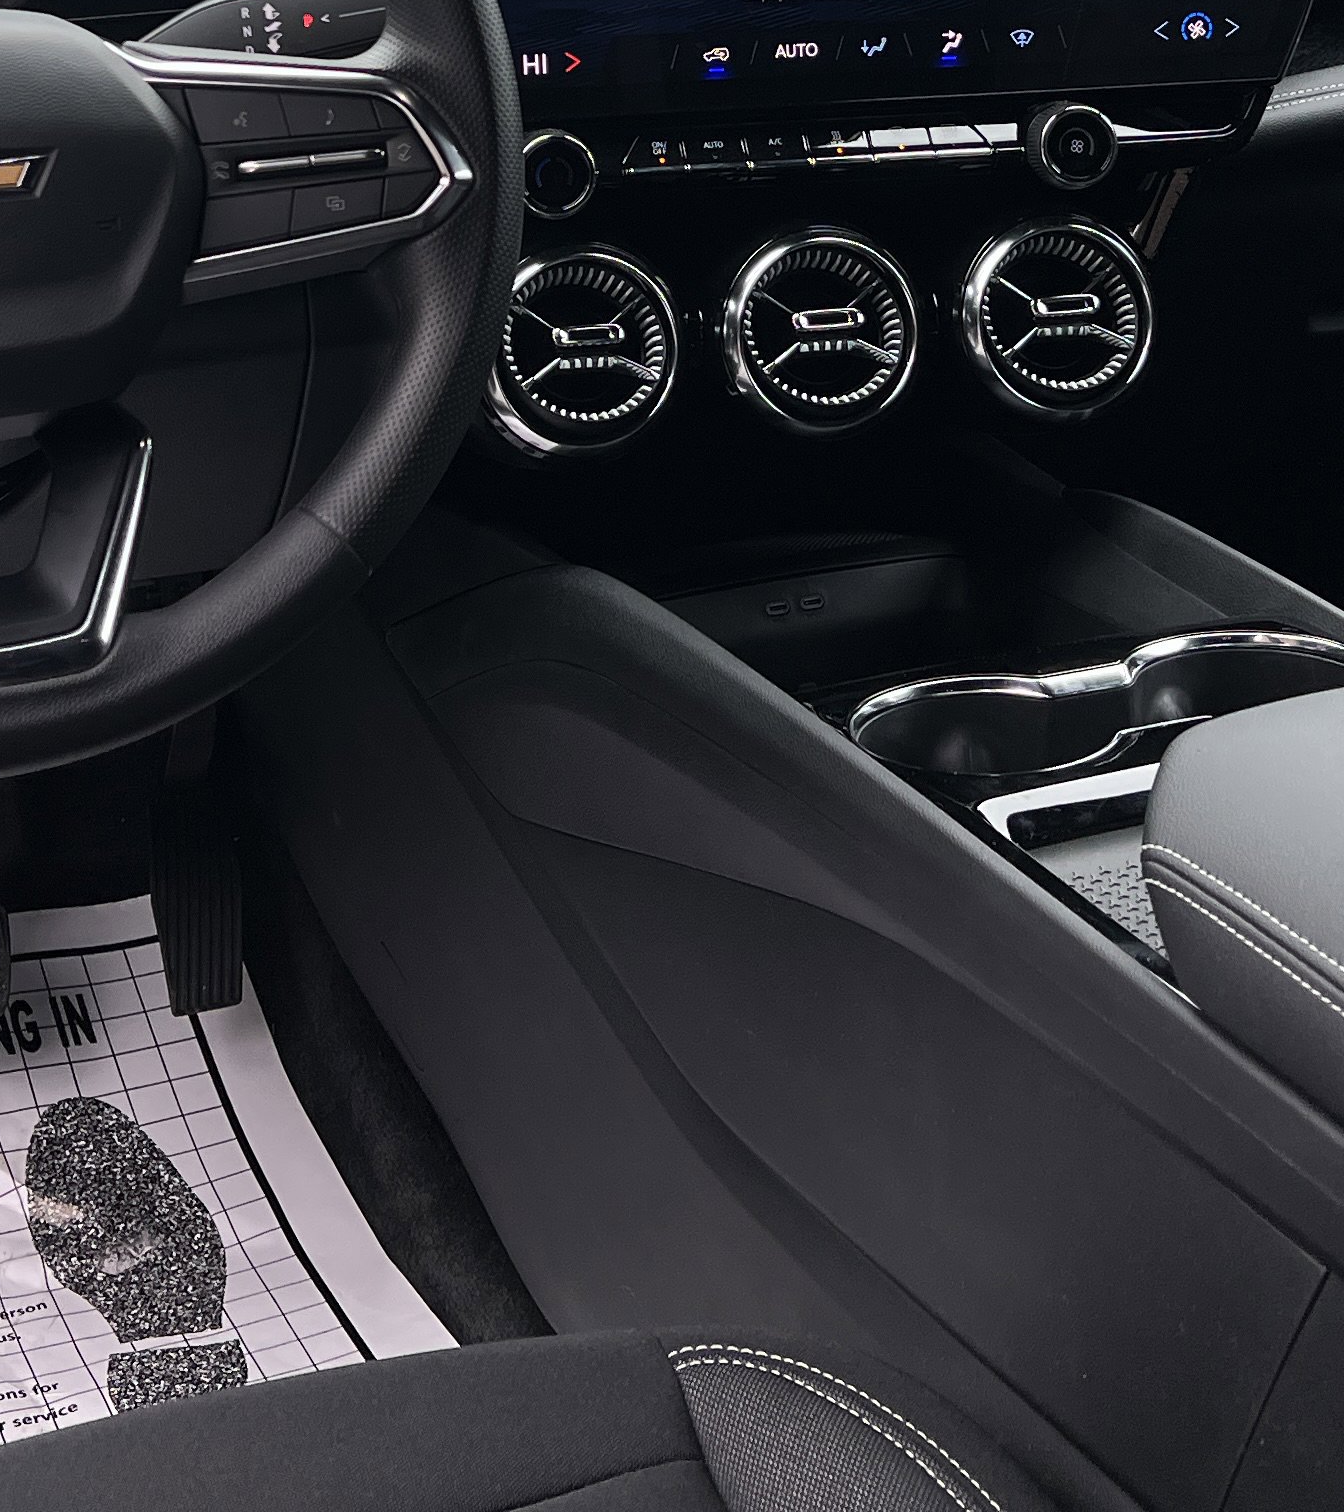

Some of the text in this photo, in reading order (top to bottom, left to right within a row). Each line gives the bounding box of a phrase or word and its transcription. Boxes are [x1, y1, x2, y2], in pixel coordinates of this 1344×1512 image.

[240, 7, 251, 19] R
[303, 13, 314, 28] P
[242, 25, 253, 37] N
[775, 43, 819, 59] AUTO
[522, 53, 548, 75] HI
[703, 141, 724, 149] AUTO
[49, 993, 98, 1048] IN
[32, 1382, 58, 1395] for
[12, 1403, 78, 1427] service
